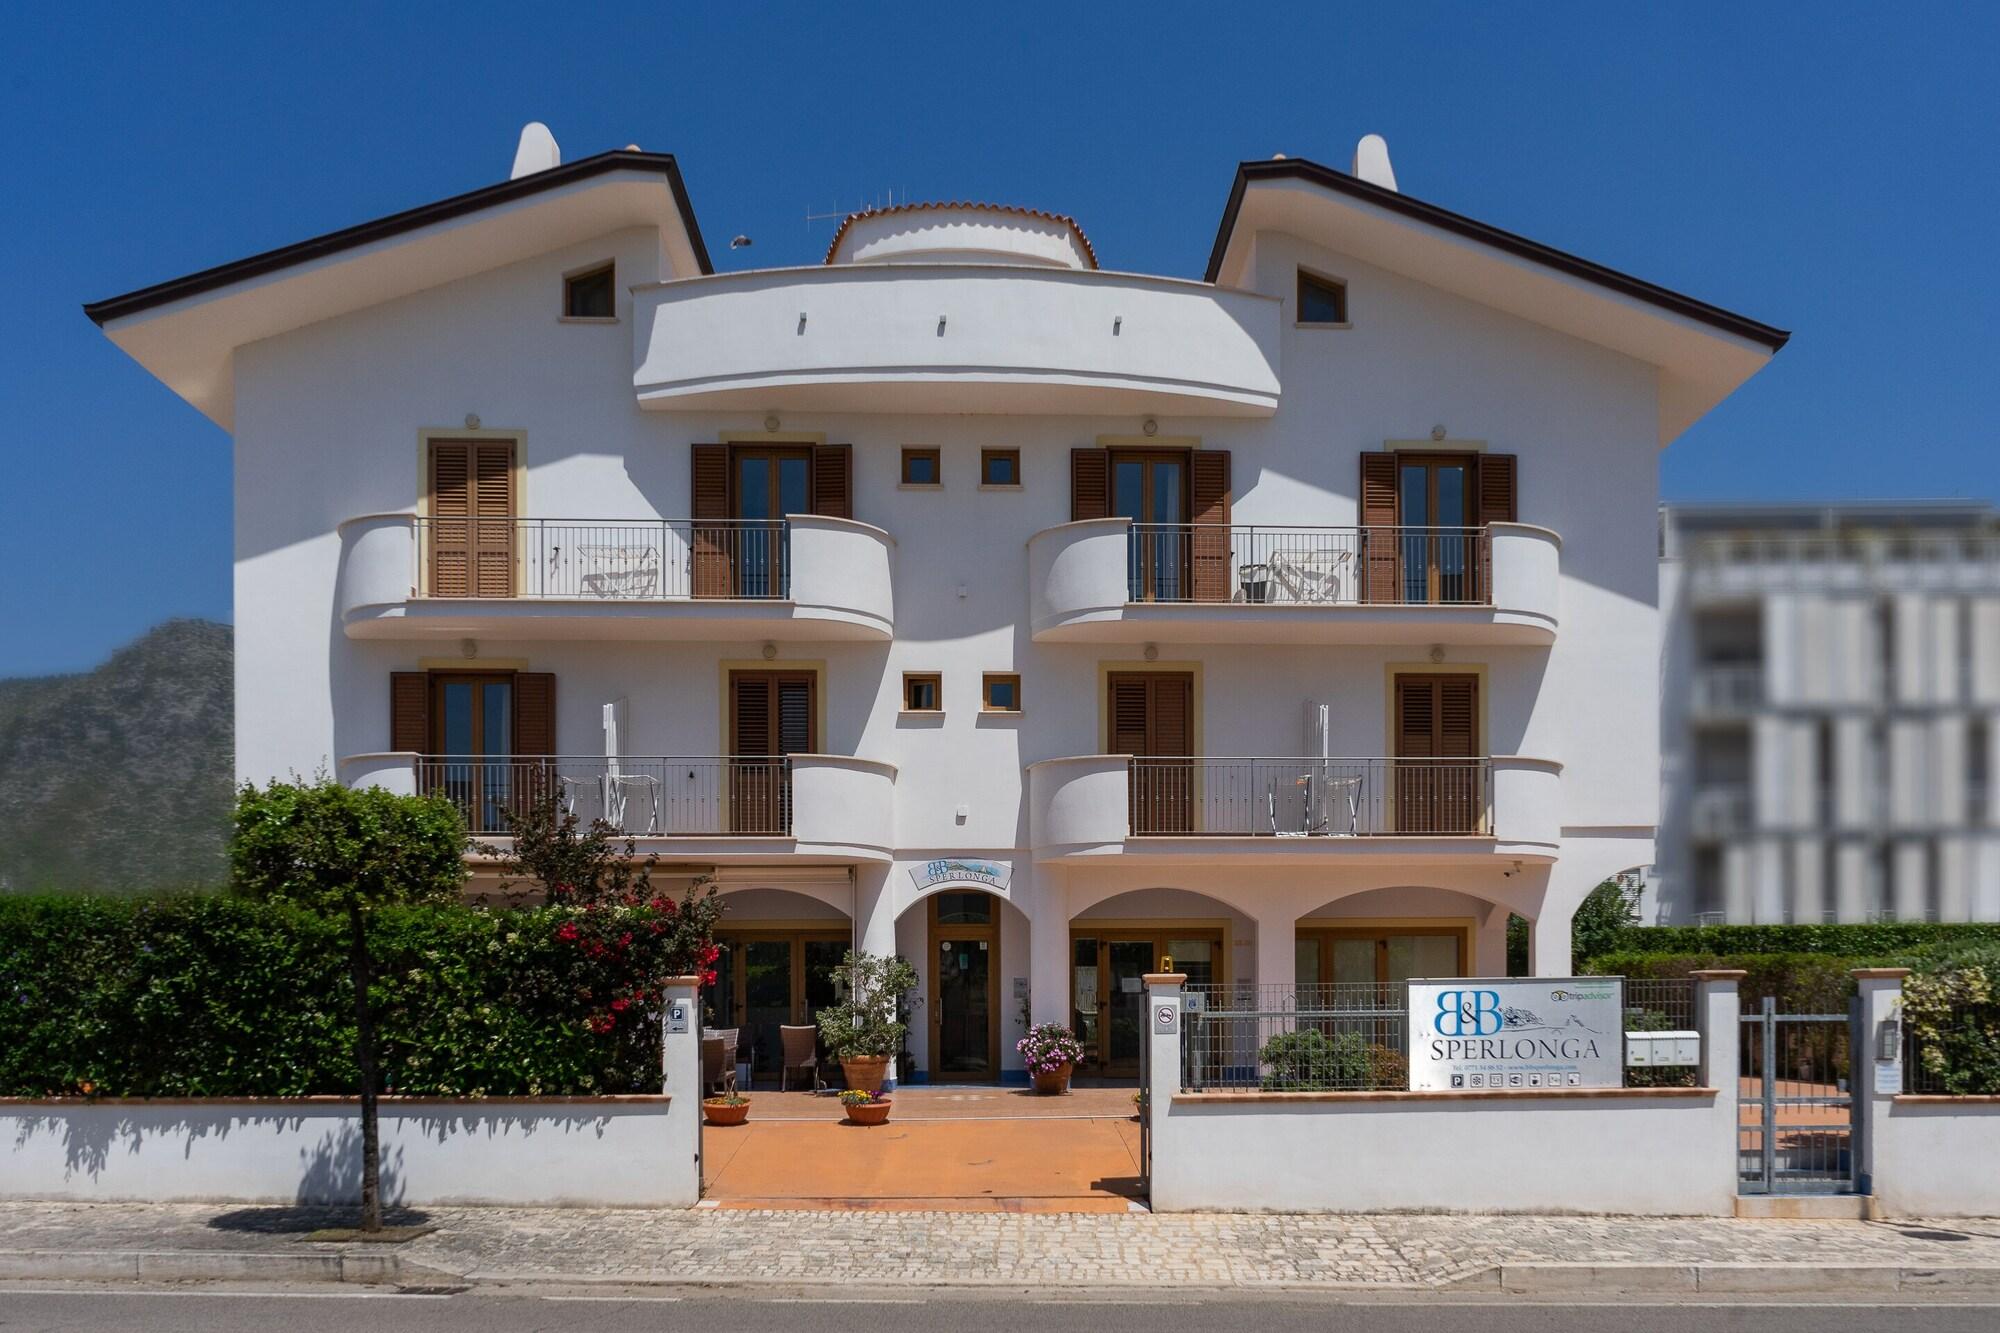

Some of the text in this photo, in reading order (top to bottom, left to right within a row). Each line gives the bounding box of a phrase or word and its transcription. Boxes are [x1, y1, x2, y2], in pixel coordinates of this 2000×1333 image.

[928, 860, 949, 875] B&B
[929, 871, 997, 885] SPERLONGA
[674, 1009, 681, 1019] P
[1434, 990, 1503, 1036] B&B
[1431, 1038, 1600, 1061] SPERLONGA
